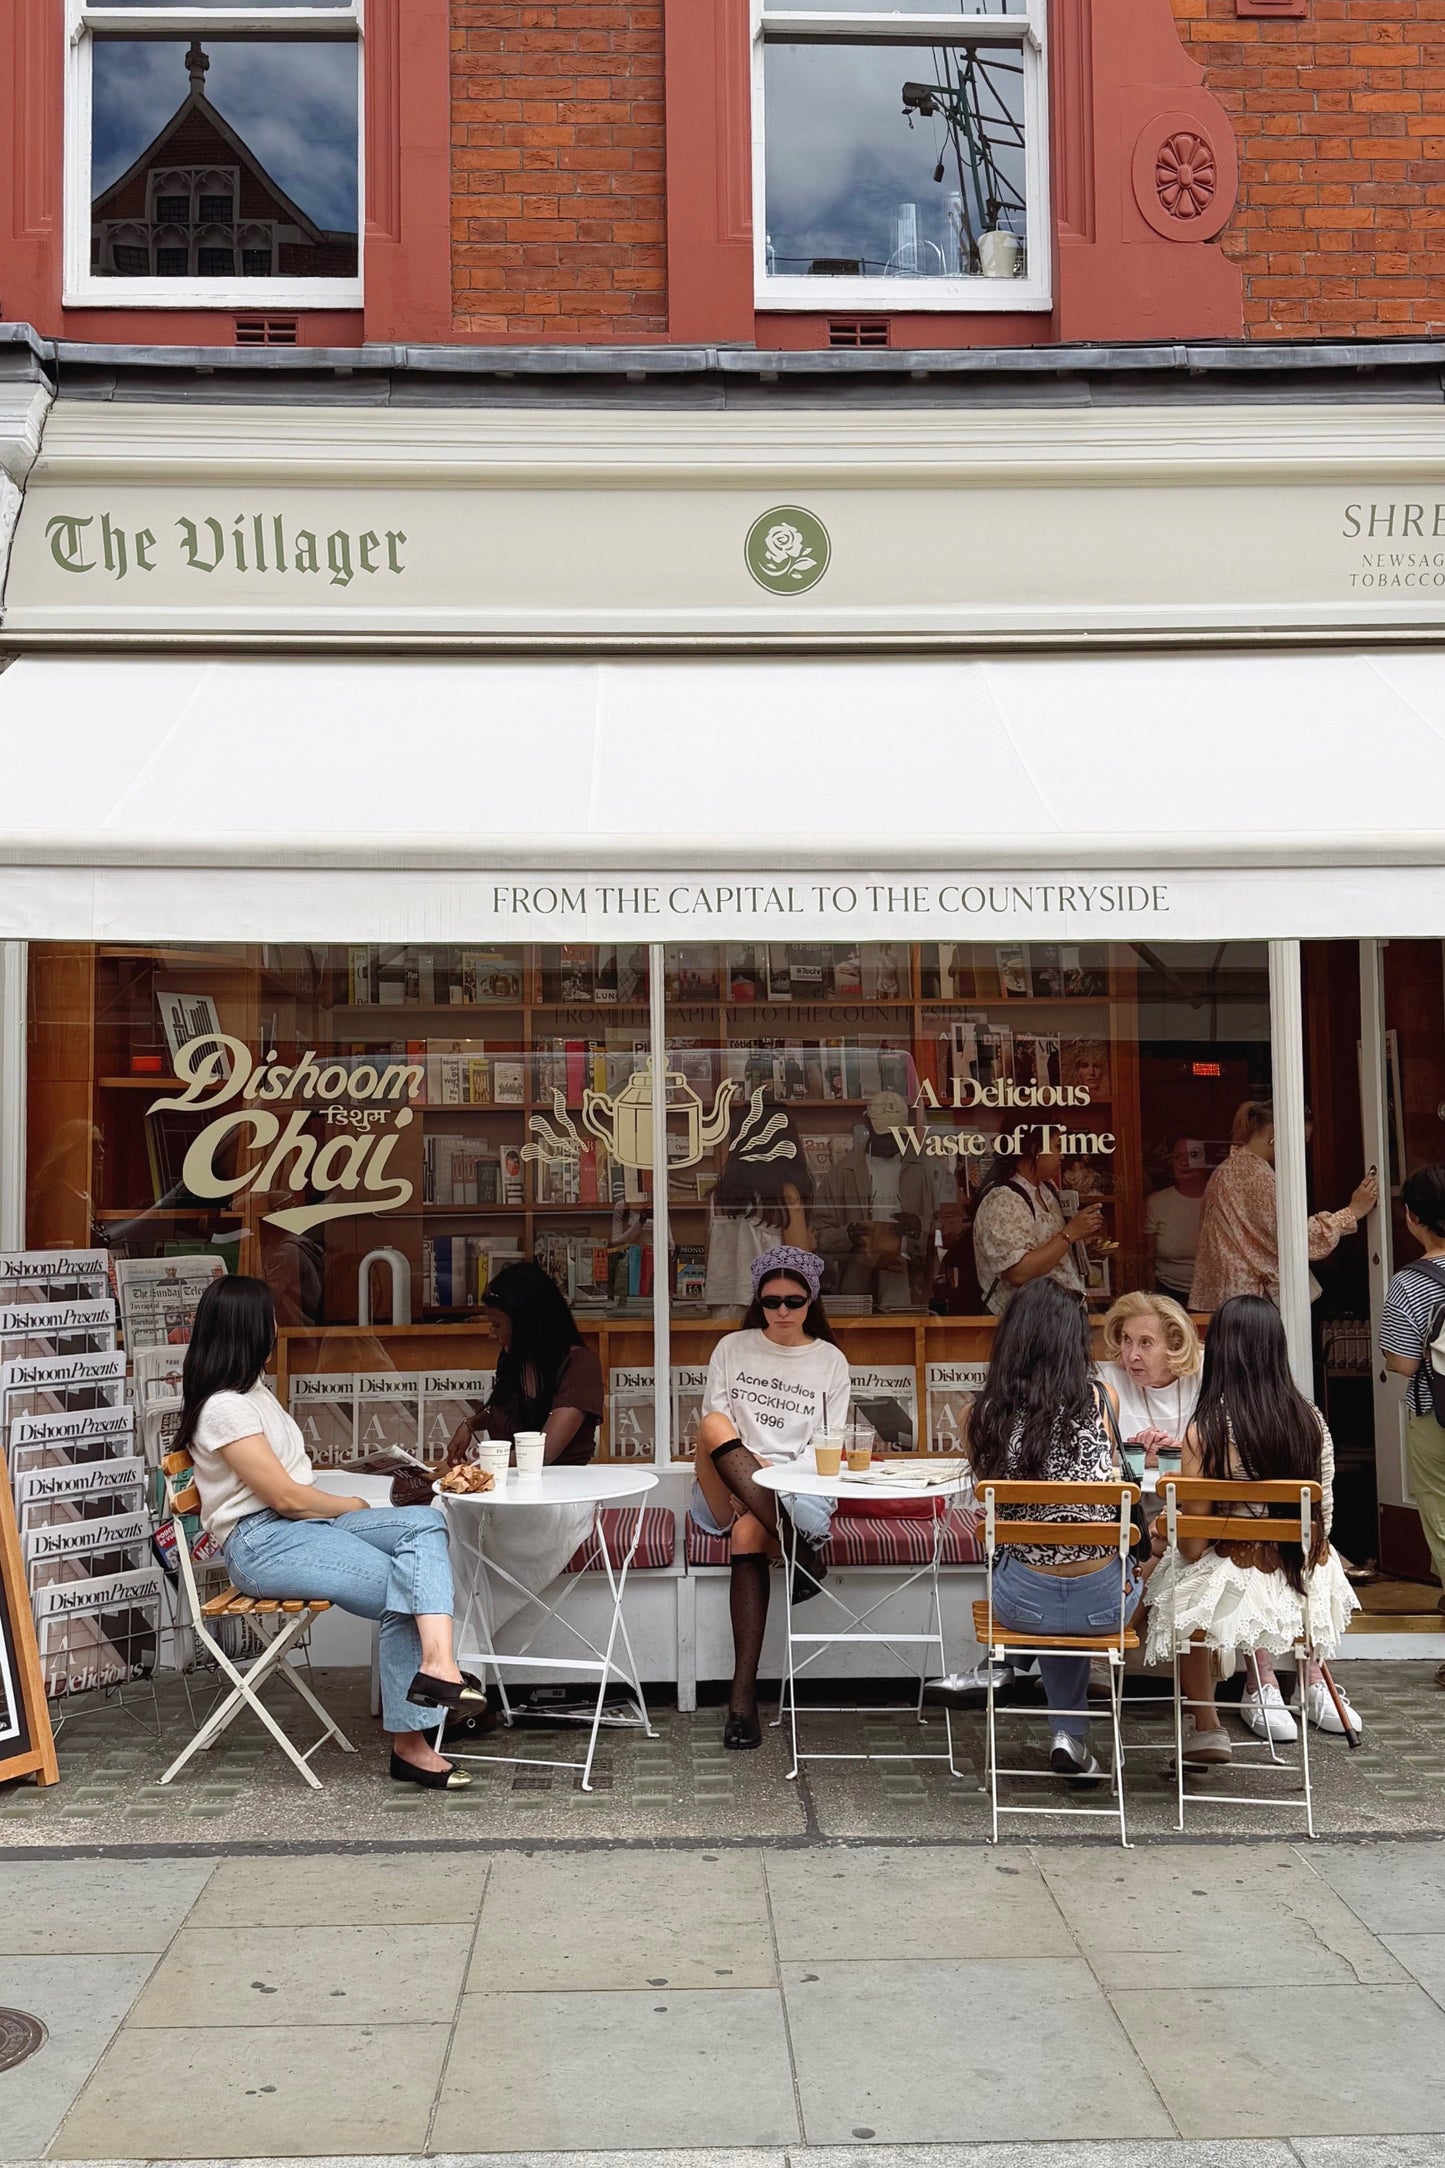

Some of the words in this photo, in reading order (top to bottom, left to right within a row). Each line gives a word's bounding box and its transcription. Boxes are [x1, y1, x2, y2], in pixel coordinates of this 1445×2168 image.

[45, 512, 157, 581] The
[174, 512, 408, 588] Villager
[1362, 553, 1445, 568] NEWSAG
[493, 887, 587, 914] FROM
[595, 887, 661, 914] THE
[668, 886, 804, 914] CAPITAL
[811, 886, 857, 913] TO
[865, 886, 930, 913] THE
[938, 885, 1170, 913] COUNTRYSIDE
[146, 1033, 425, 1117] Dishoom
[912, 1079, 940, 1108] A
[949, 1077, 1091, 1108] Delicious
[888, 1125, 986, 1156] Waste
[994, 1124, 1027, 1155] of
[1028, 1124, 1115, 1155] Time
[182, 1106, 414, 1236] Chai
[56, 1258, 104, 1274] Presents
[3, 1311, 62, 1330] Dishoom
[62, 1308, 110, 1325] Presents
[10, 1366, 71, 1384] Dishoom
[71, 1361, 119, 1378] Presents
[360, 1377, 419, 1394] Dishoom
[424, 1376, 482, 1392] Dishoom
[736, 1370, 769, 1387] Acne
[771, 1378, 816, 1400] Studios
[866, 1372, 914, 1389] Presents
[295, 1379, 354, 1395] Dishoom
[730, 1387, 816, 1417] STOCKHOLM
[20, 1423, 80, 1441] Dishoom
[80, 1416, 128, 1434] Presents
[754, 1411, 785, 1430] 1996
[29, 1476, 89, 1497] Dishoom
[89, 1469, 137, 1488] Presents
[35, 1532, 96, 1554] Dishoom
[96, 1521, 143, 1544] Presents
[50, 1589, 109, 1612] Dishoom
[109, 1579, 159, 1601] Presents
